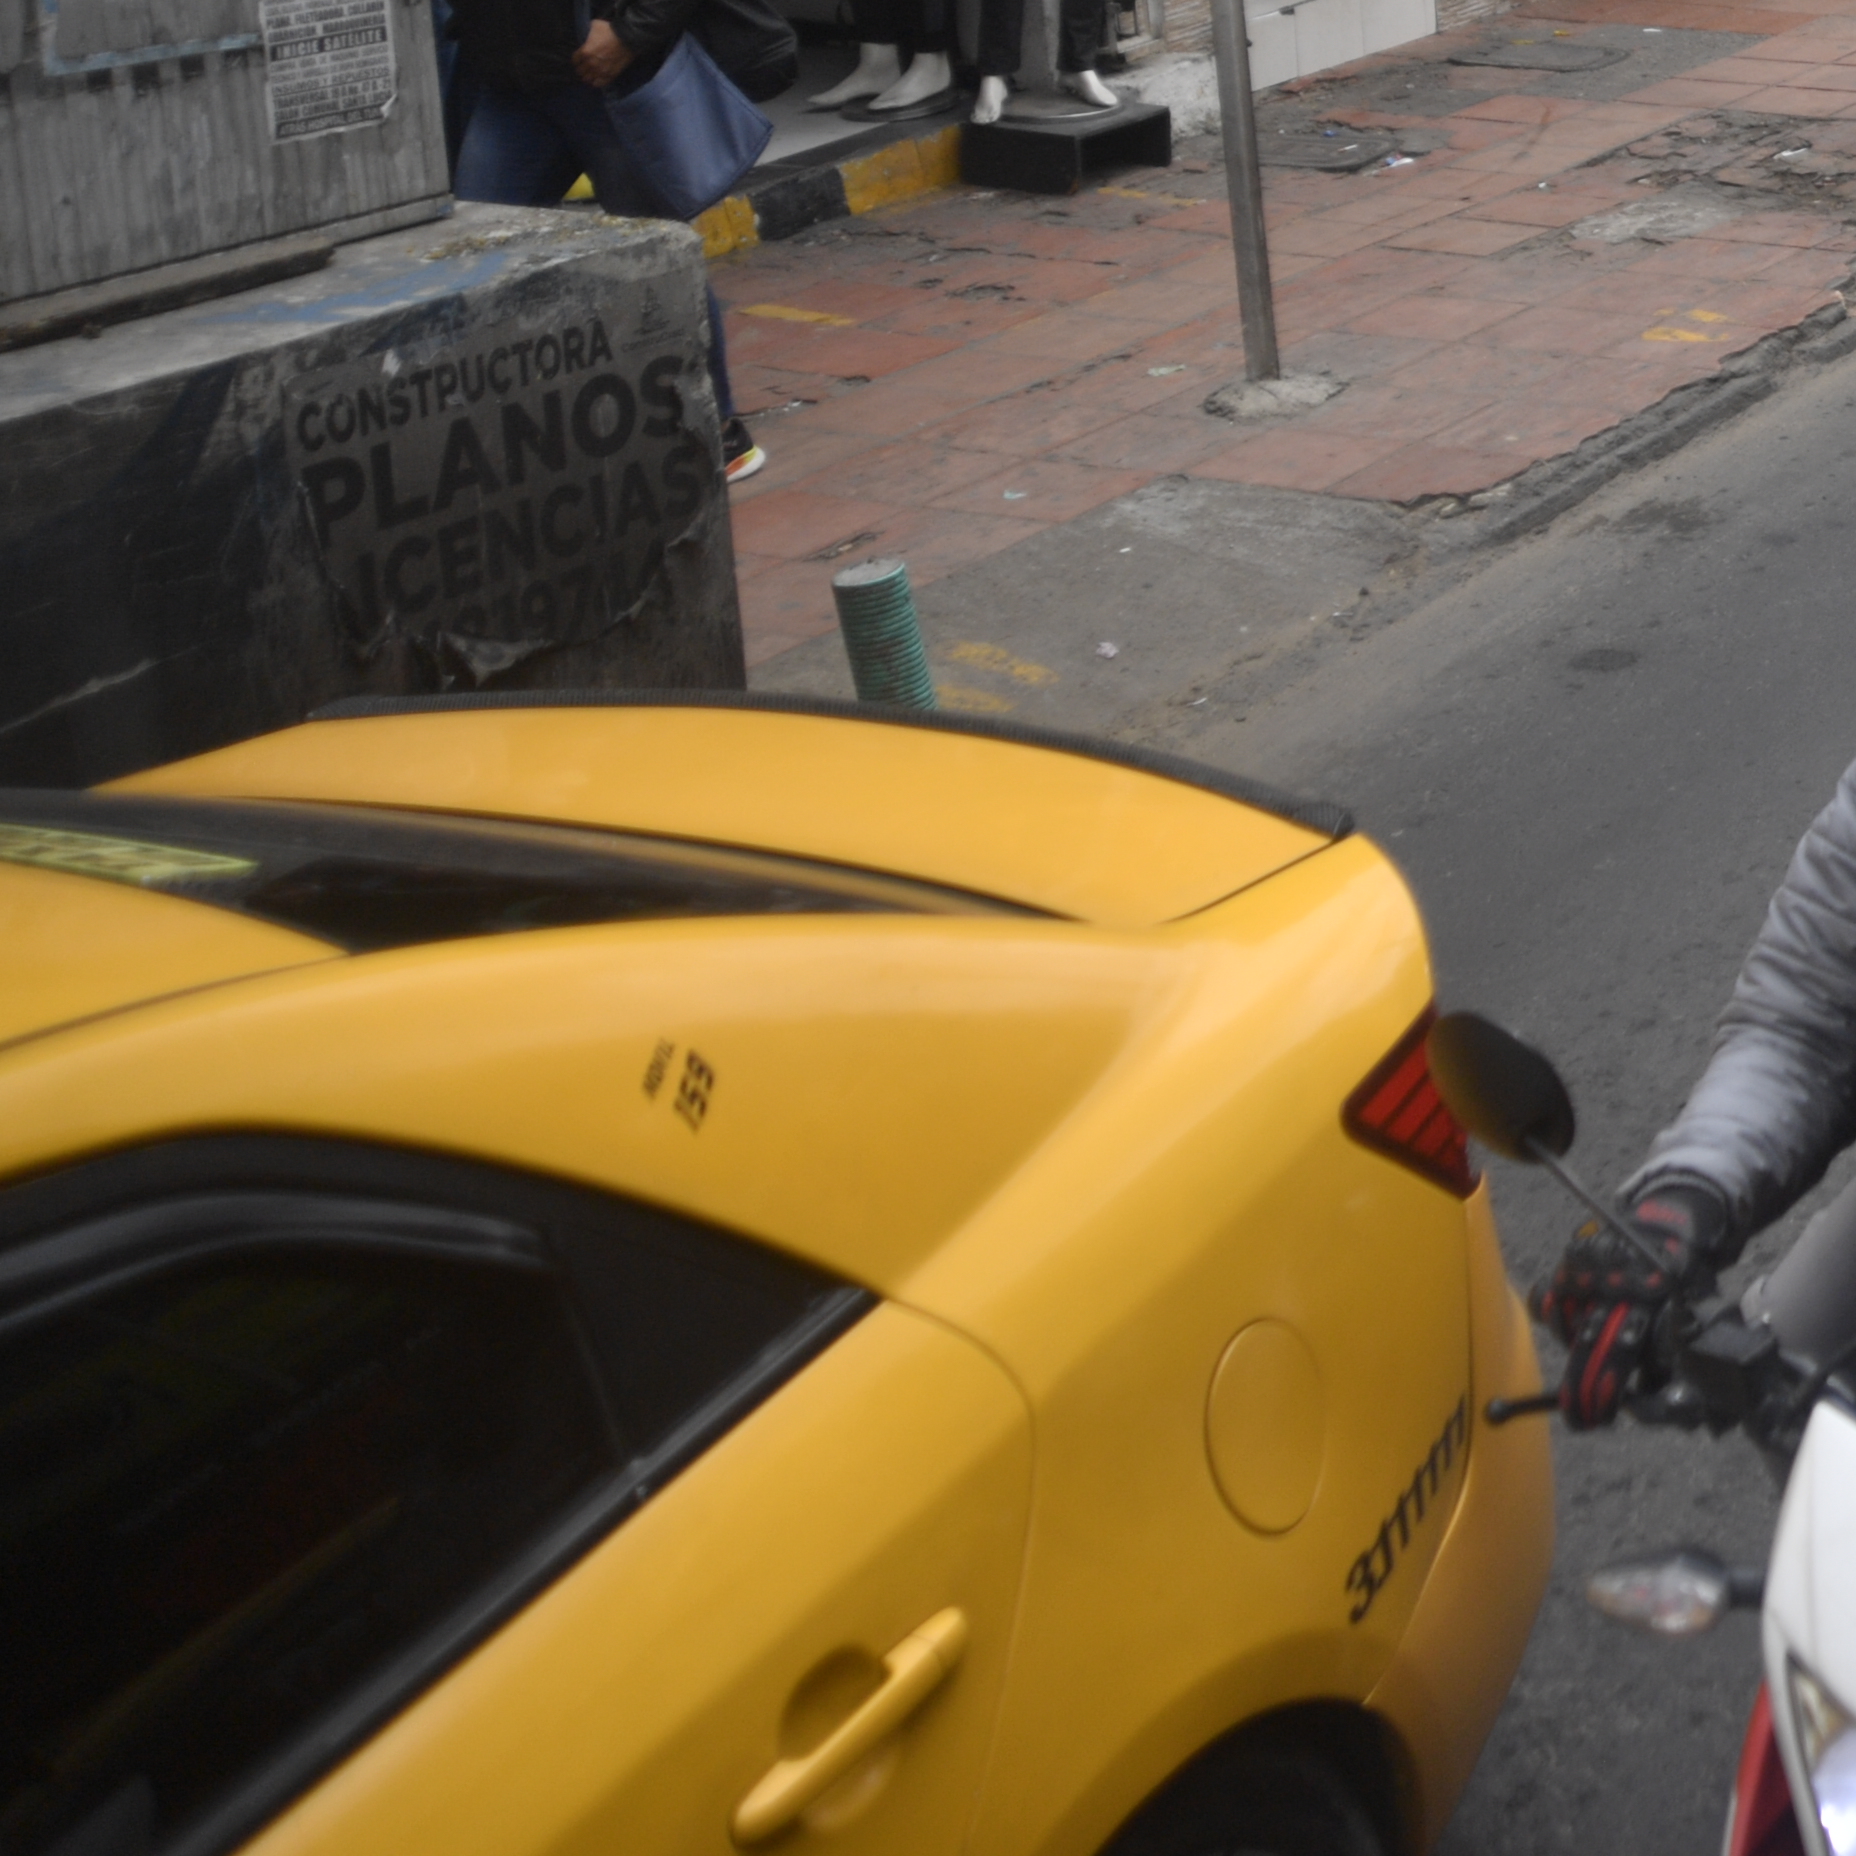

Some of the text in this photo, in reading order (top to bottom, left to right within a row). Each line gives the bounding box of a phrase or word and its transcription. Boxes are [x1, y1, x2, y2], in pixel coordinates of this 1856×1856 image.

[275, 28, 384, 60] INICIE SATELITE
[301, 352, 686, 553] PLANOS
